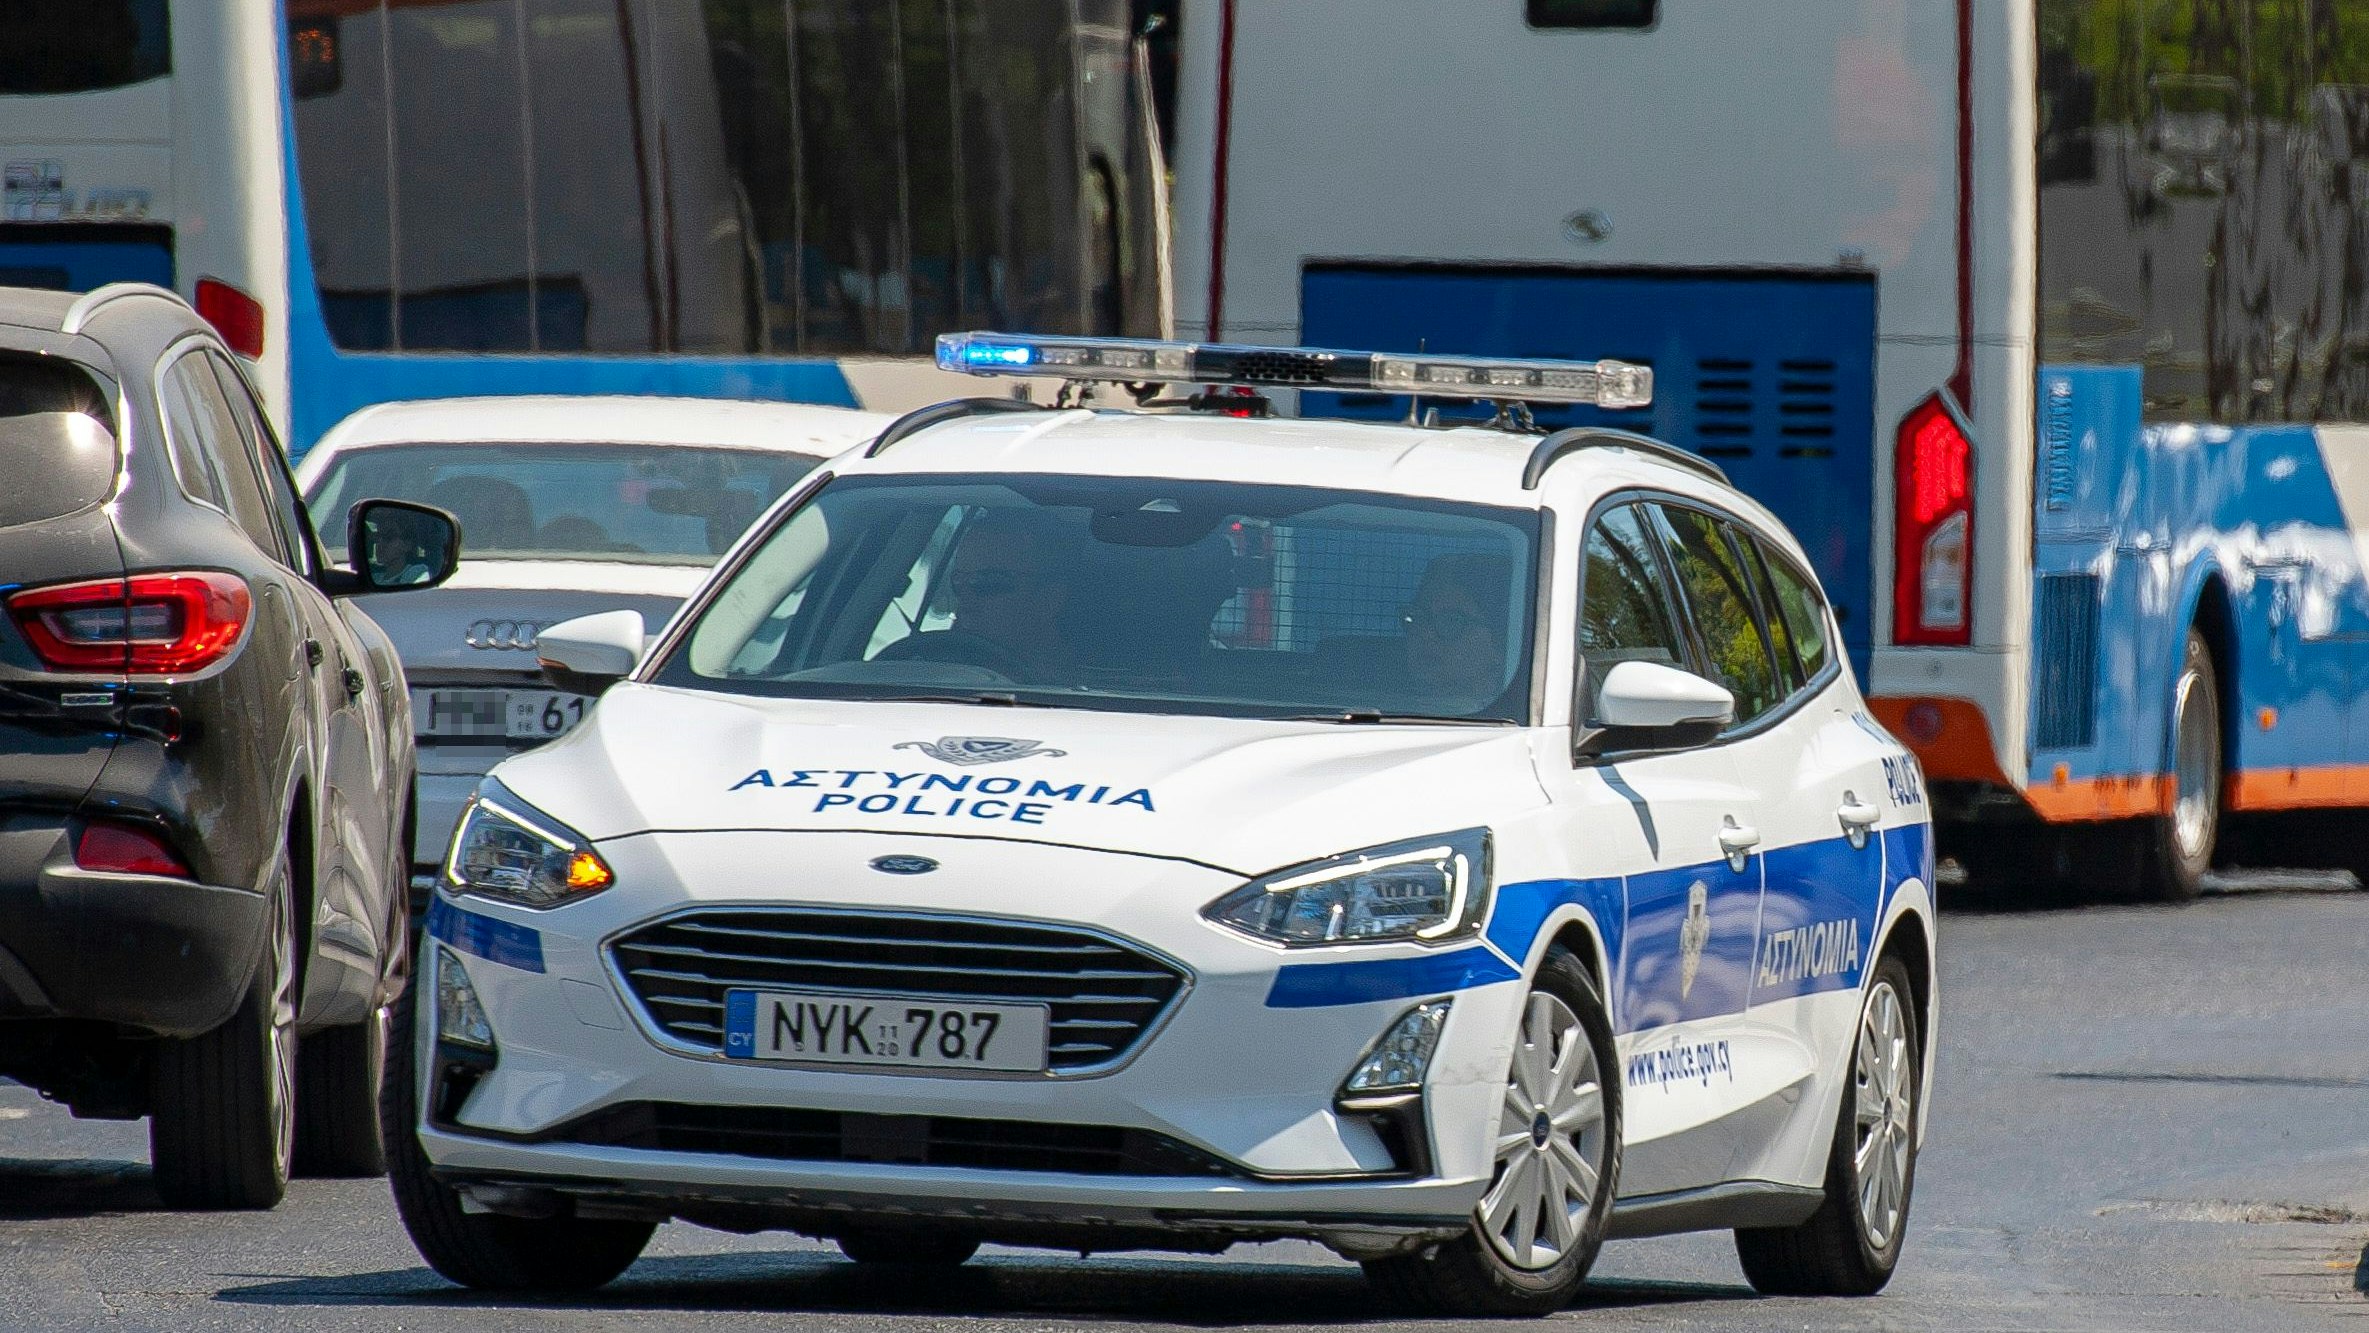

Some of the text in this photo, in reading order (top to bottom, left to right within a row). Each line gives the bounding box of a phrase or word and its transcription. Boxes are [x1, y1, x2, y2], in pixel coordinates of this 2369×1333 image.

[728, 769, 1156, 812] ΑΣΤΥΝΟΜΙΑ
[812, 793, 1053, 825] POLICE
[1757, 918, 1858, 988] ΑΣΤΥΝΟΜΙΑ
[728, 1032, 752, 1047] CY
[772, 1001, 1001, 1062] NYK 787
